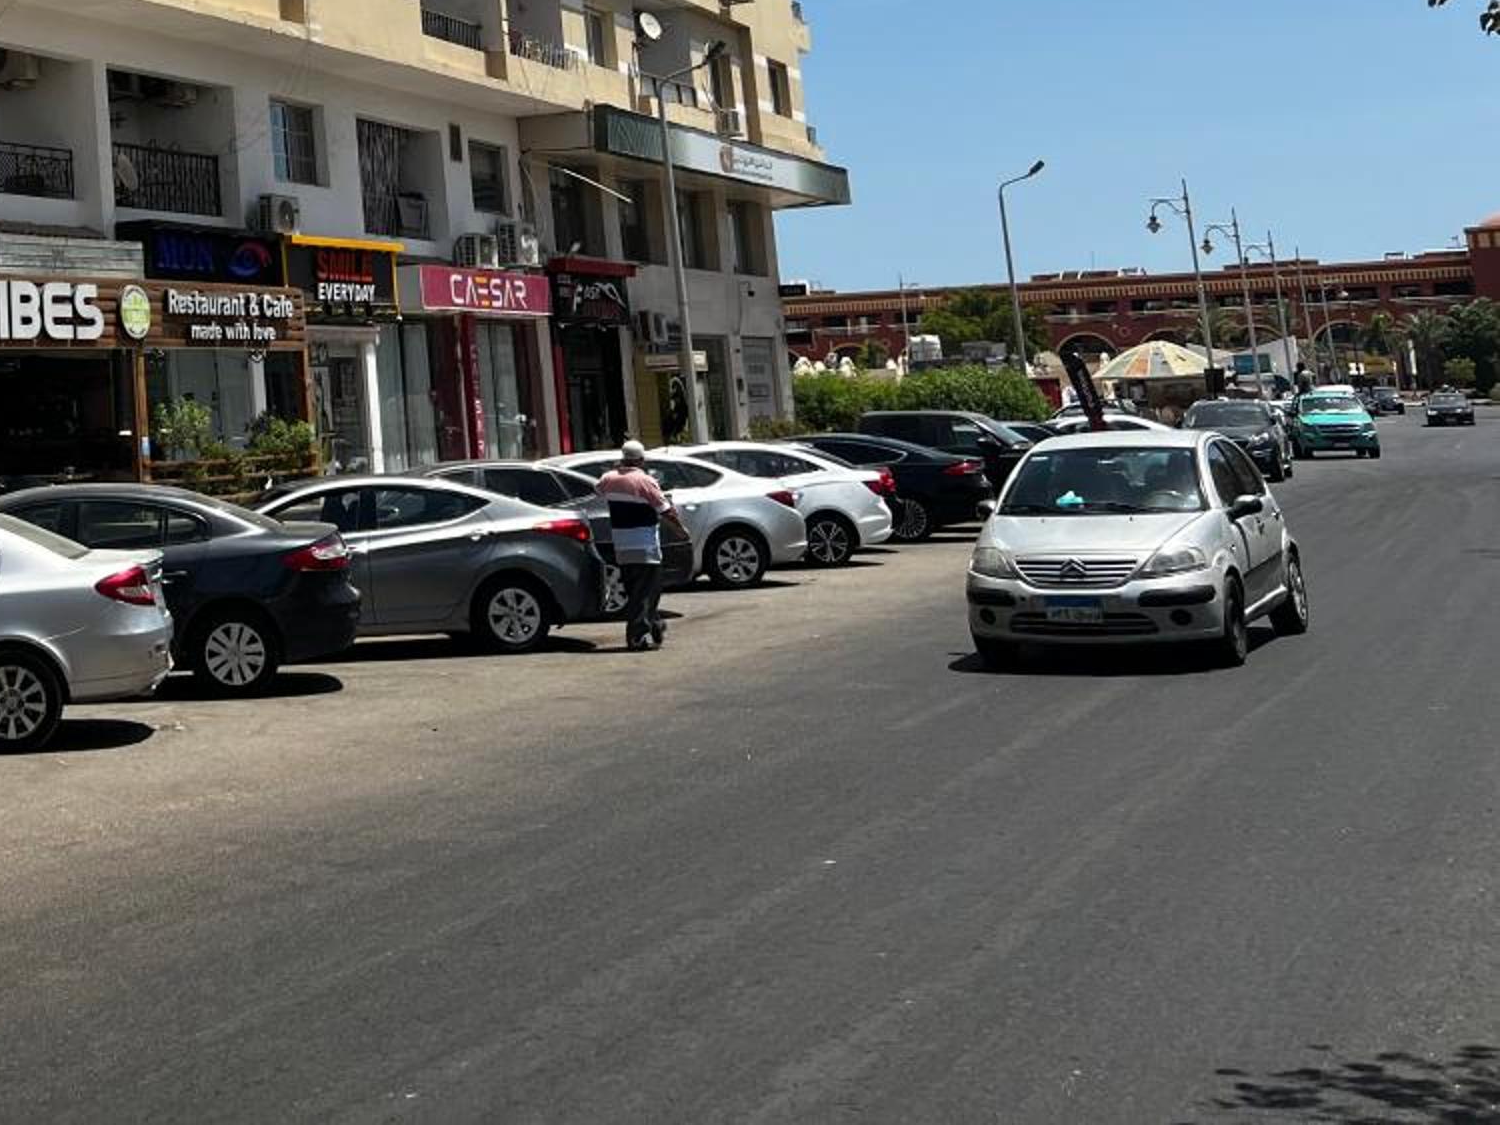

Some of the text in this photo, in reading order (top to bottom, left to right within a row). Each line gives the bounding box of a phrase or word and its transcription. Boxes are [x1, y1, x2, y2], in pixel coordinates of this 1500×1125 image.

[316, 250, 373, 282] SMILE
[167, 288, 246, 317] Restaurant
[249, 292, 261, 317] &
[263, 293, 294, 318] Cafe
[450, 274, 528, 310] CAESAR
[190, 318, 277, 341] made with love
